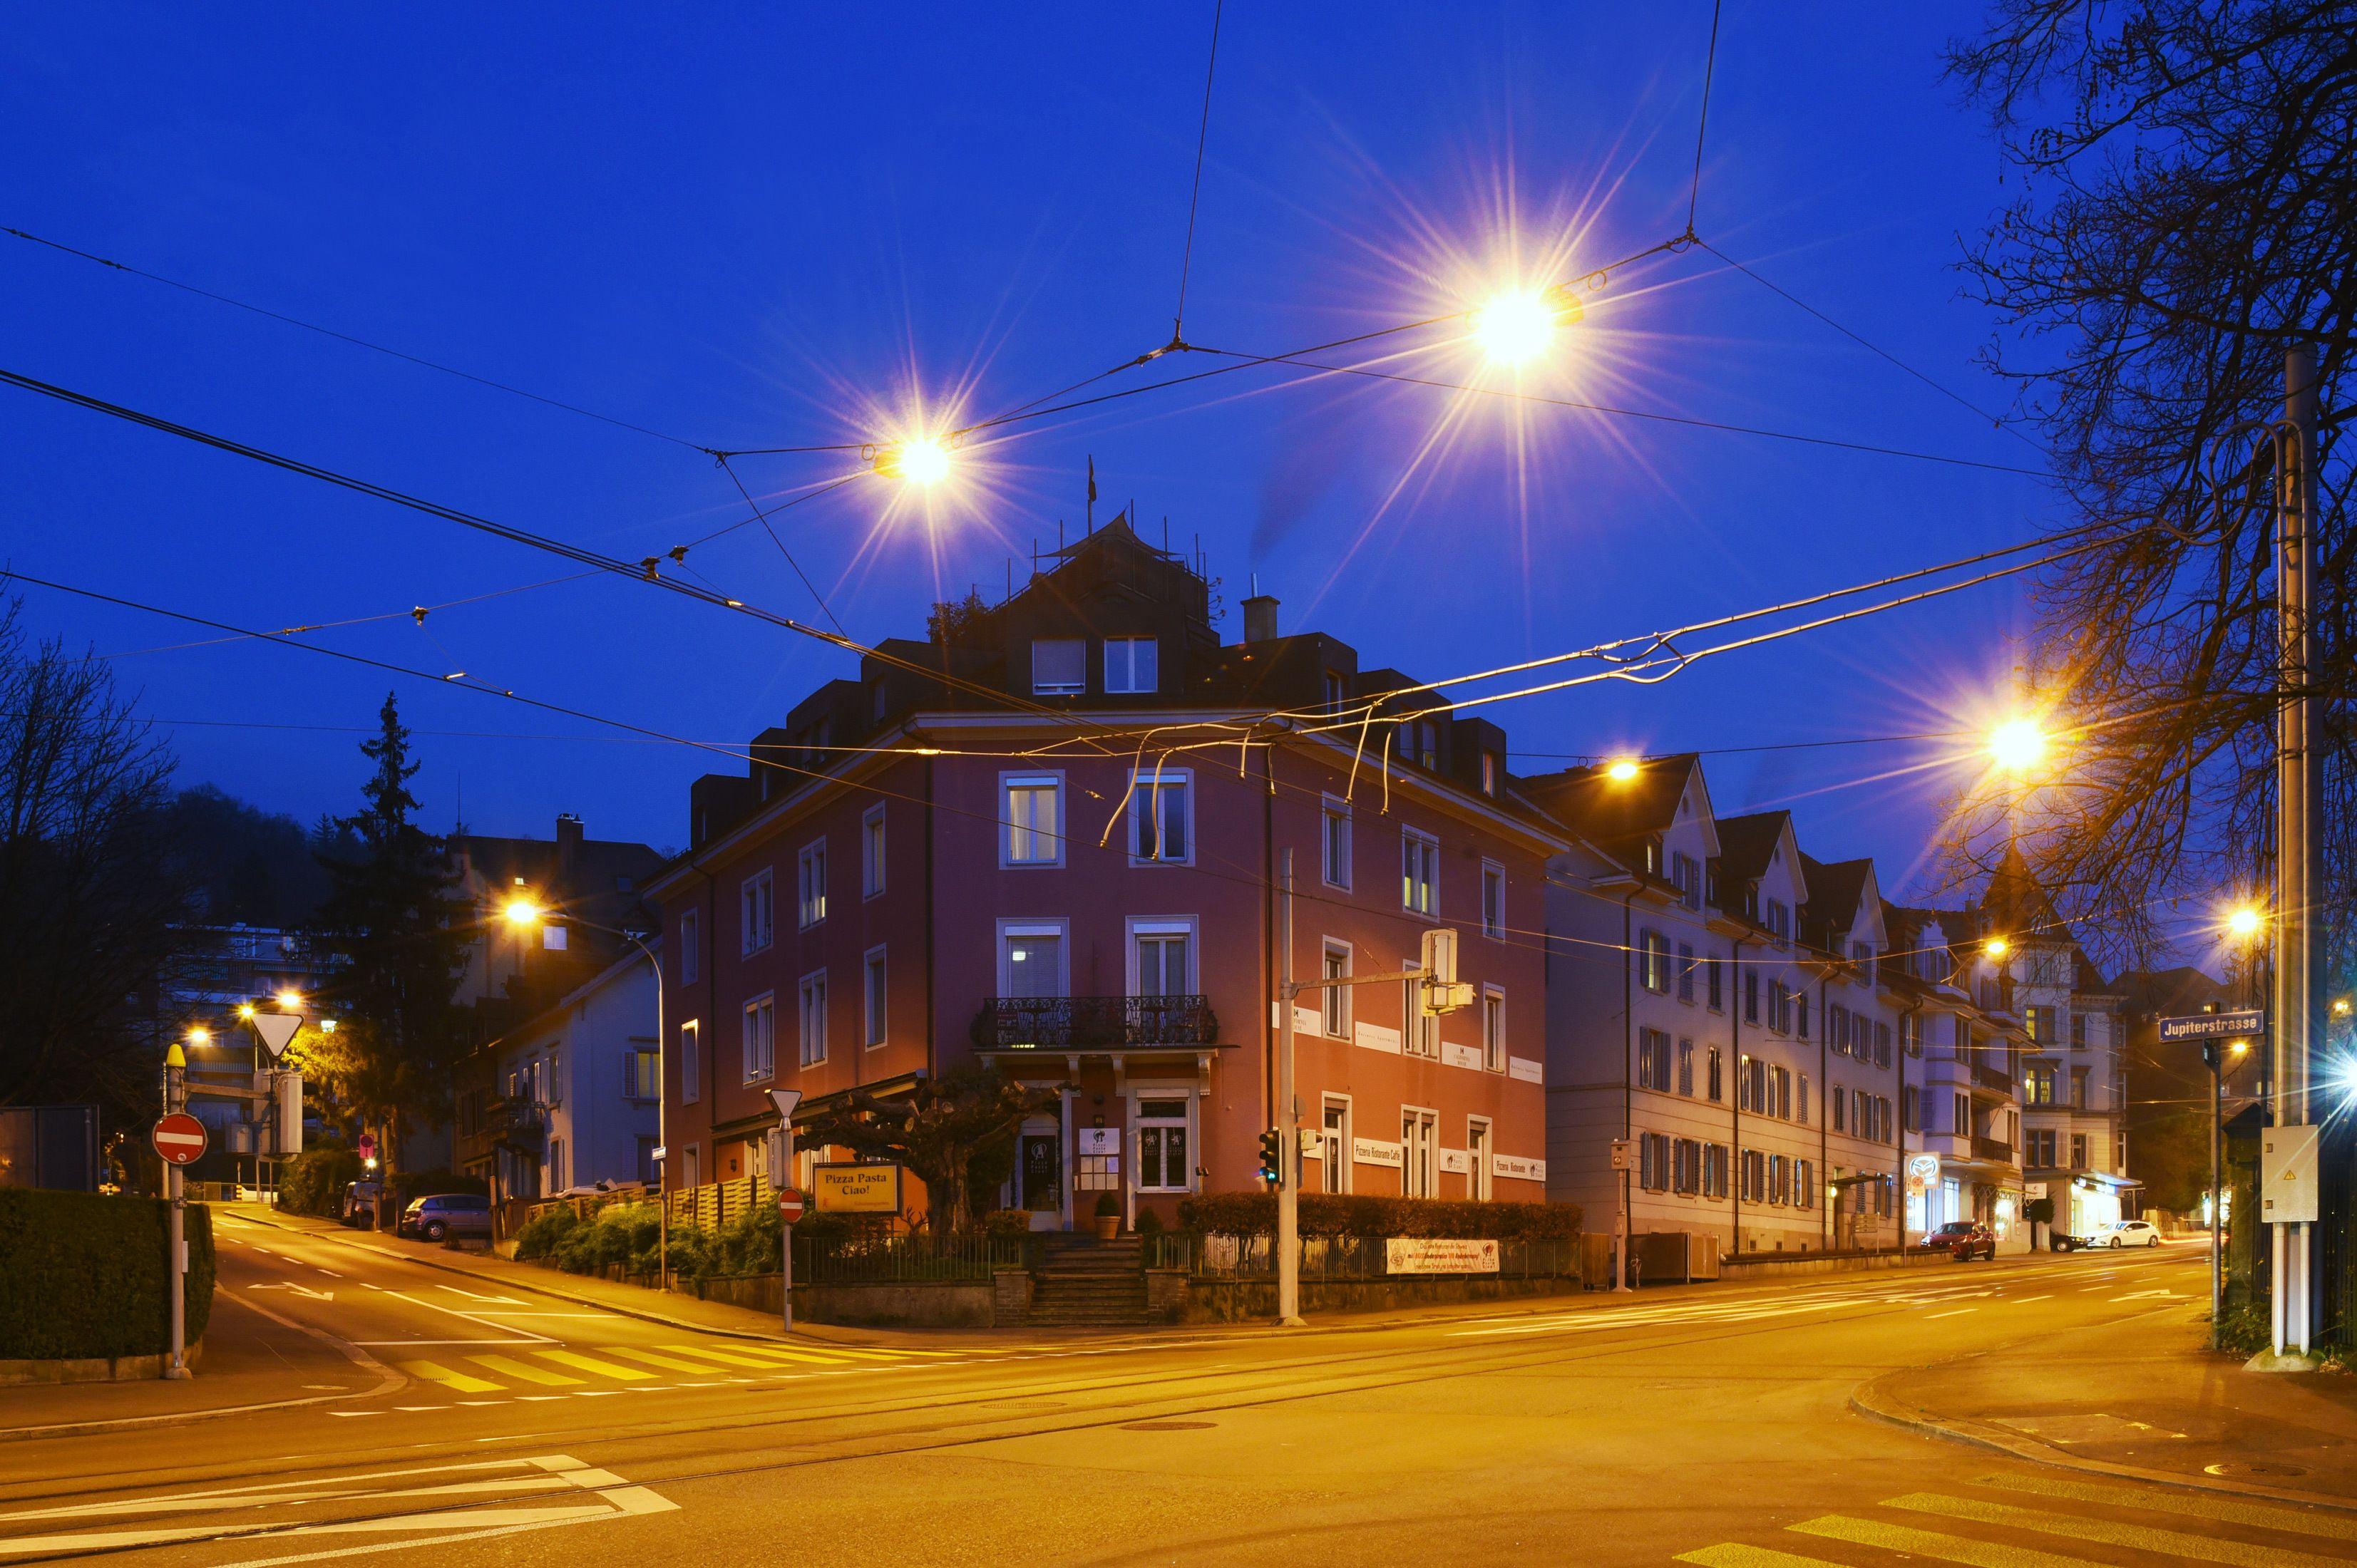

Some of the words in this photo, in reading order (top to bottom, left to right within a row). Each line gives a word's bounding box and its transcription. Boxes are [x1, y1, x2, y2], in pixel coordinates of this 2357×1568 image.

[2165, 1018, 2257, 1037] Jupiterstrasse
[1356, 1145, 1370, 1157] Pizzeria
[1371, 1147, 1390, 1160] Ristorante
[1496, 1160, 1509, 1171] Pizzeria
[1510, 1162, 1526, 1173] Ristorante
[825, 1174, 854, 1183] Pizza
[858, 1173, 887, 1183] Pasta
[842, 1185, 870, 1195] Ciao!
